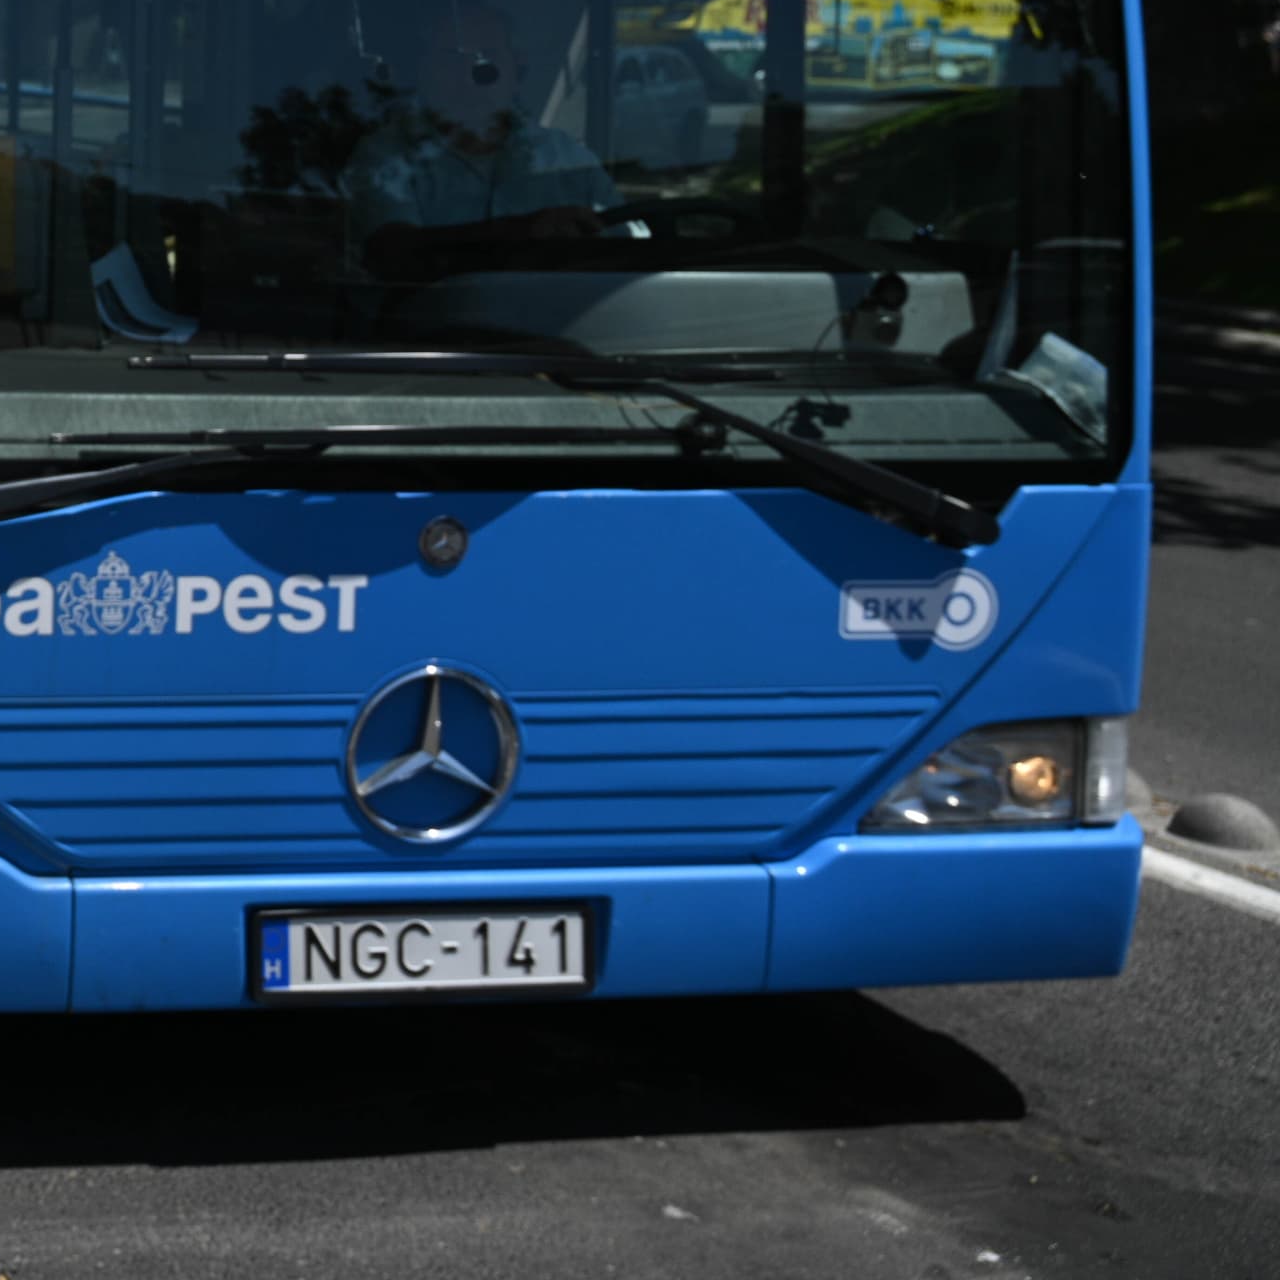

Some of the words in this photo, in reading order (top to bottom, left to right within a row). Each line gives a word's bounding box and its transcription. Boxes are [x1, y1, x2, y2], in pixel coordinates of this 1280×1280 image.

[862, 596, 928, 621] BKK
[263, 959, 282, 980] H
[304, 918, 570, 982] NGC-141
